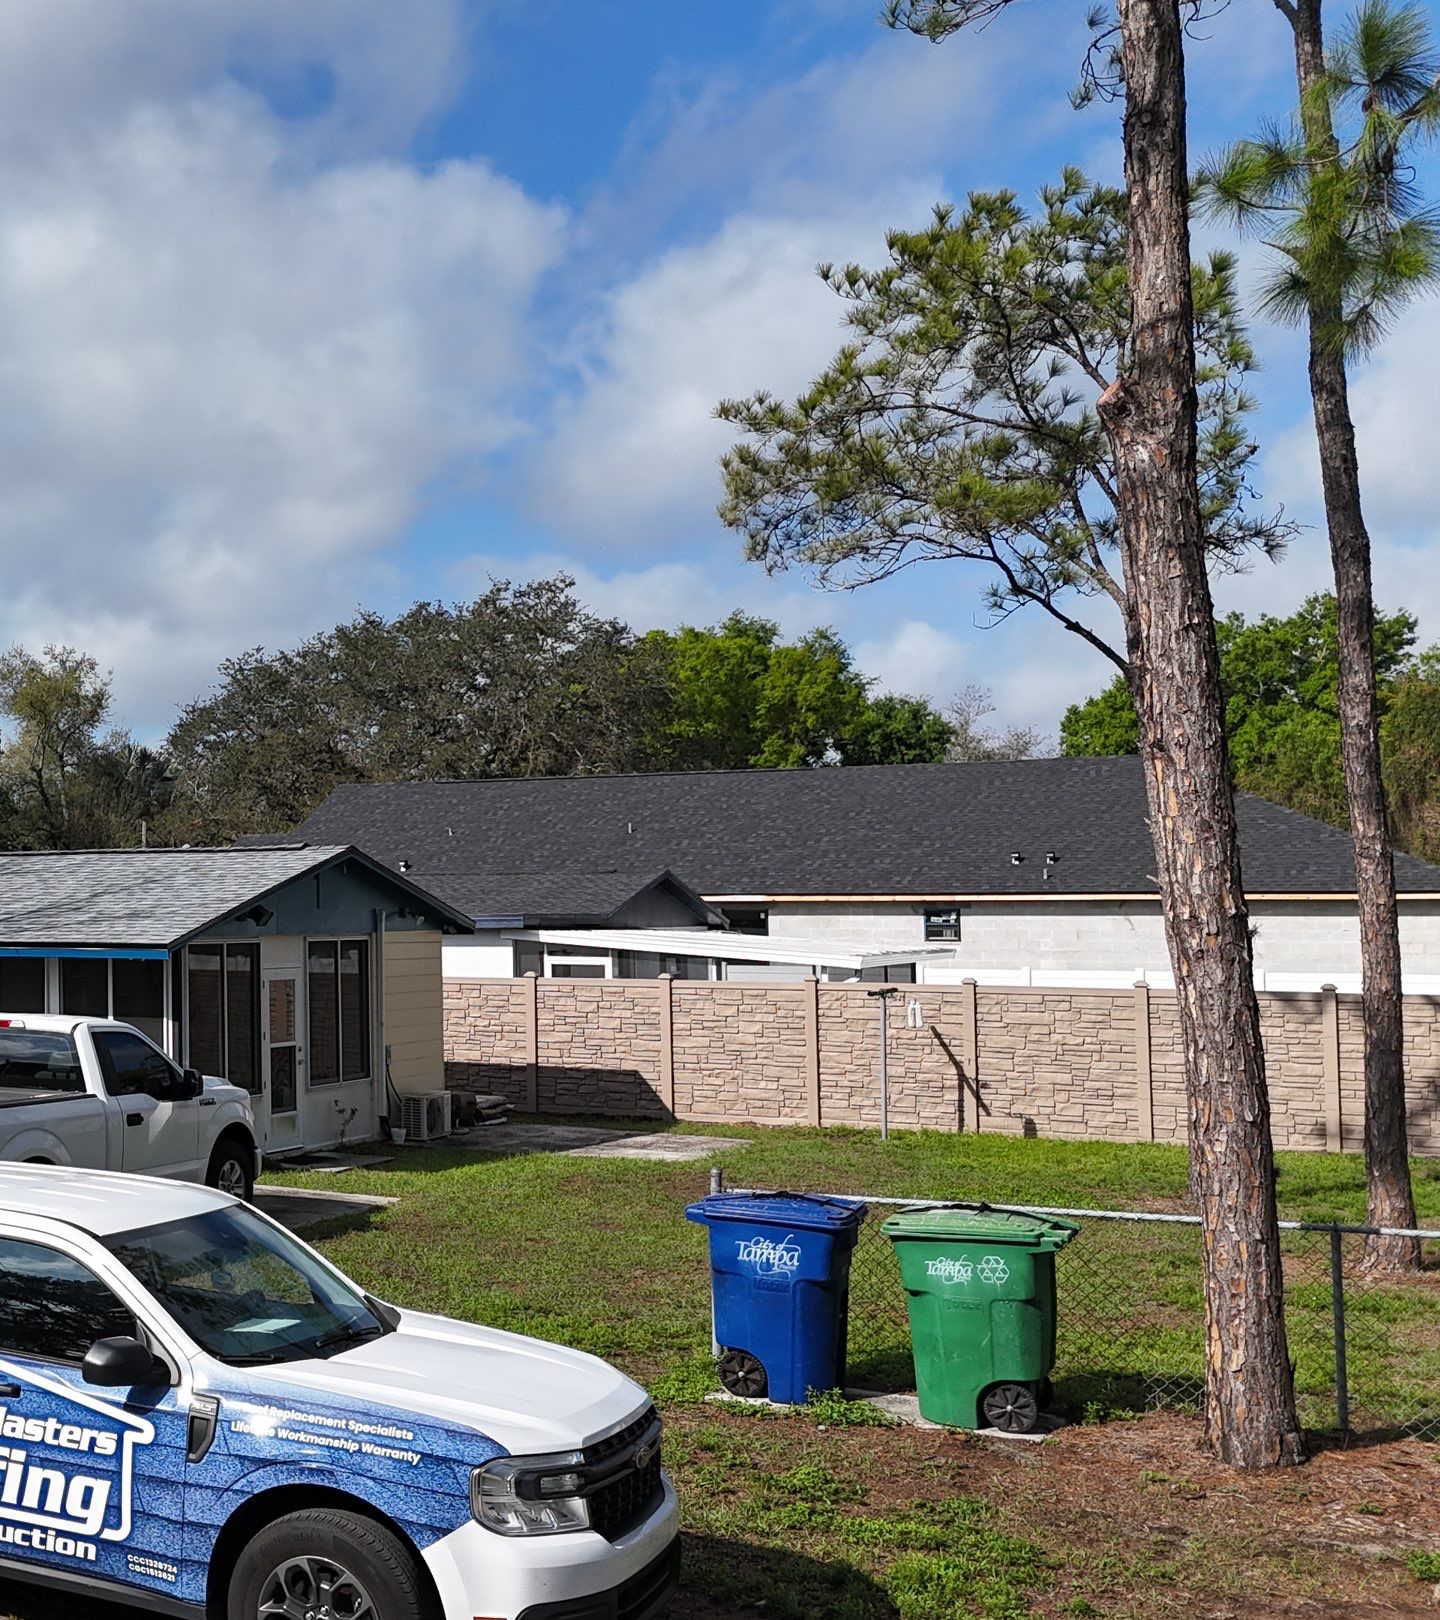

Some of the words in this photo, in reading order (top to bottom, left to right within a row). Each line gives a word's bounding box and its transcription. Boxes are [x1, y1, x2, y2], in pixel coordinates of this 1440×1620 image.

[735, 1240, 800, 1271] Tampa
[924, 1260, 973, 1281] Tampa
[269, 1406, 347, 1428] Replacement
[347, 1419, 415, 1442] Specialists
[231, 1420, 276, 1437] Lifee
[277, 1428, 360, 1453] Workmanship
[360, 1442, 421, 1466] Warranty
